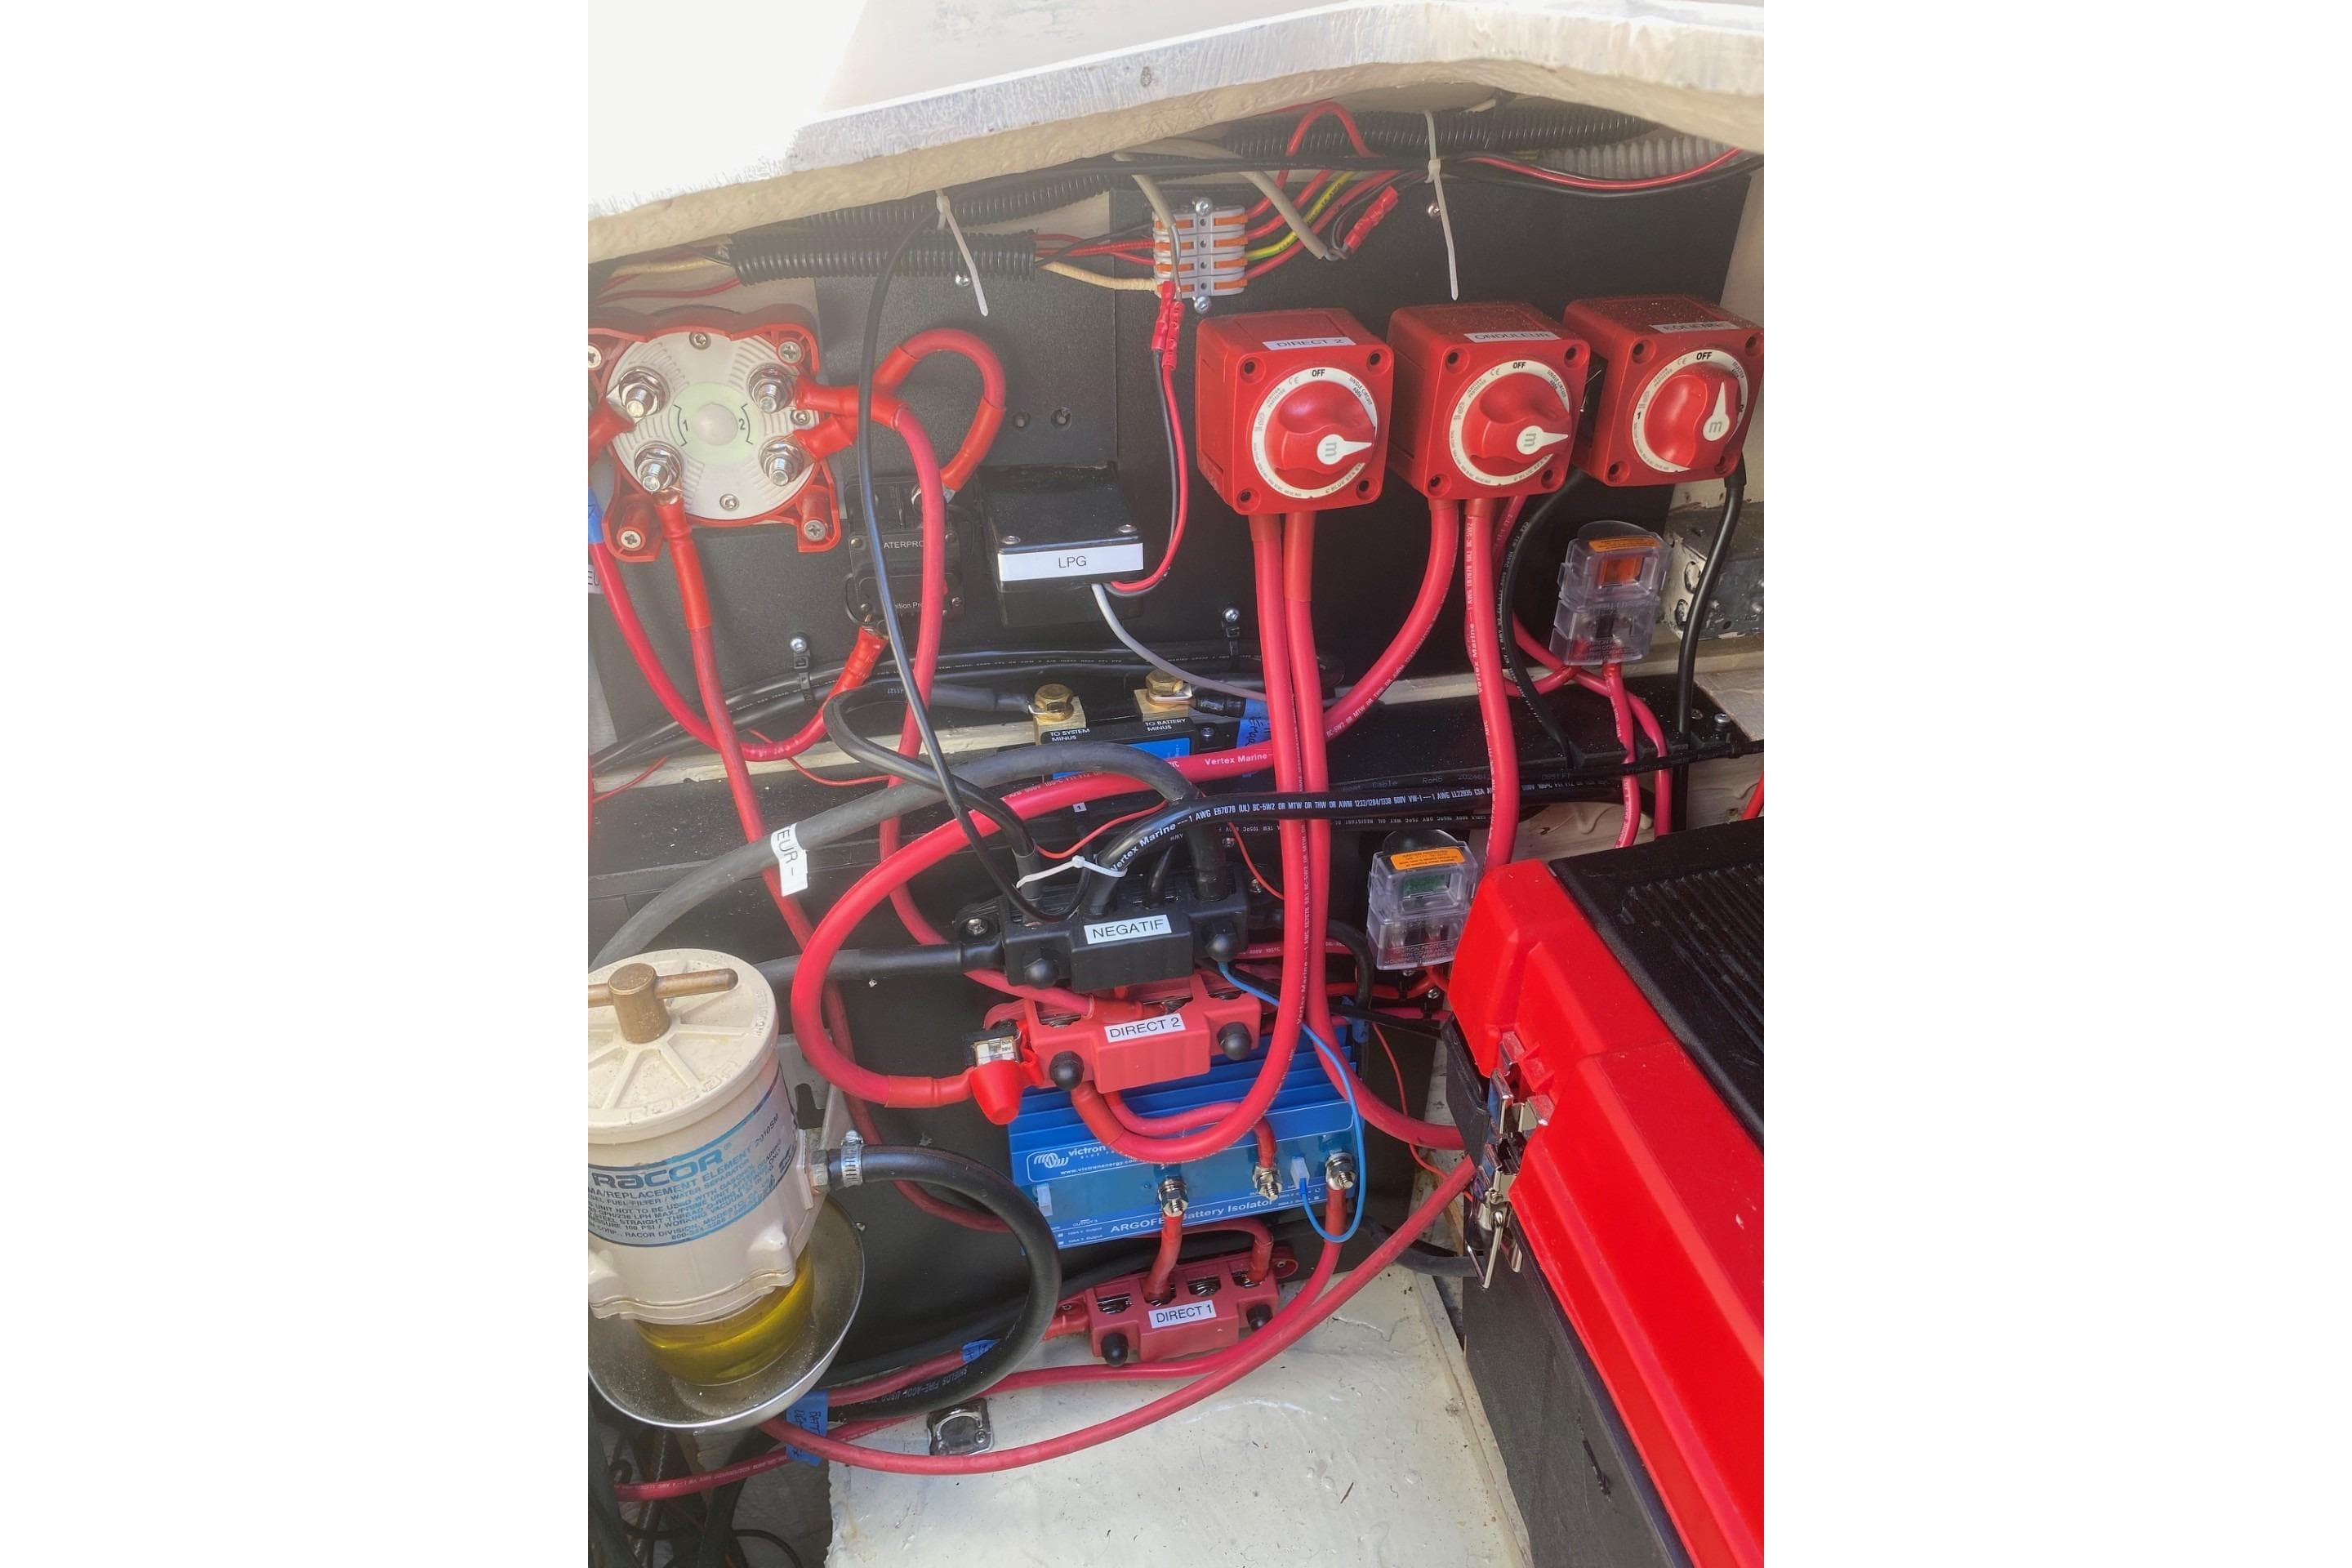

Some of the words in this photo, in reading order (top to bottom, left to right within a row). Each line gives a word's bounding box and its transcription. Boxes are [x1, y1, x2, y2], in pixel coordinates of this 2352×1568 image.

[1276, 338, 1328, 347] DIRECT
[1474, 332, 1551, 341] ONDULEUR
[1696, 351, 1712, 360] OFF
[1513, 361, 1526, 369] OFF
[1312, 368, 1325, 377] OFF
[1637, 411, 1642, 420] 1
[683, 419, 688, 432] 1
[738, 418, 746, 430] 2
[884, 540, 925, 550] ATERPRO
[1058, 555, 1088, 568] LPG
[1468, 622, 1477, 659] Marine
[1473, 660, 1483, 694] Vertex
[1156, 718, 1186, 726] BATTERY
[1062, 728, 1090, 736] SYSTEM
[1205, 757, 1236, 765] Vertex
[1237, 753, 1268, 763] Marine
[1423, 776, 1443, 784] RoHS
[1111, 845, 1138, 871] Vertex
[1139, 822, 1177, 848] Marine
[1196, 809, 1211, 821] AWG
[1238, 804, 1250, 813] (UL)
[1288, 801, 1303, 810] MTW
[1304, 801, 1312, 809] OR
[1315, 800, 1327, 809] THW
[1329, 800, 1337, 808] OR
[1339, 800, 1353, 808] AWM
[1408, 795, 1423, 803] VW-1
[1437, 792, 1450, 800] AWG
[1474, 787, 1485, 795] CSA
[777, 829, 799, 864] EUR
[1092, 919, 1164, 938] NEGATIF
[1109, 1019, 1167, 1039] DIRECT
[1171, 1017, 1181, 1027] 2
[1068, 1145, 1107, 1157] victron
[702, 1146, 752, 1183] ELEMENT
[607, 1199, 628, 1207] FUEL
[670, 1187, 702, 1201] WATER
[1111, 1217, 1165, 1234] ARGOFE
[1227, 1198, 1274, 1213] Isolator
[1156, 1305, 1203, 1323] DIRECT
[1207, 1304, 1213, 1314] 1
